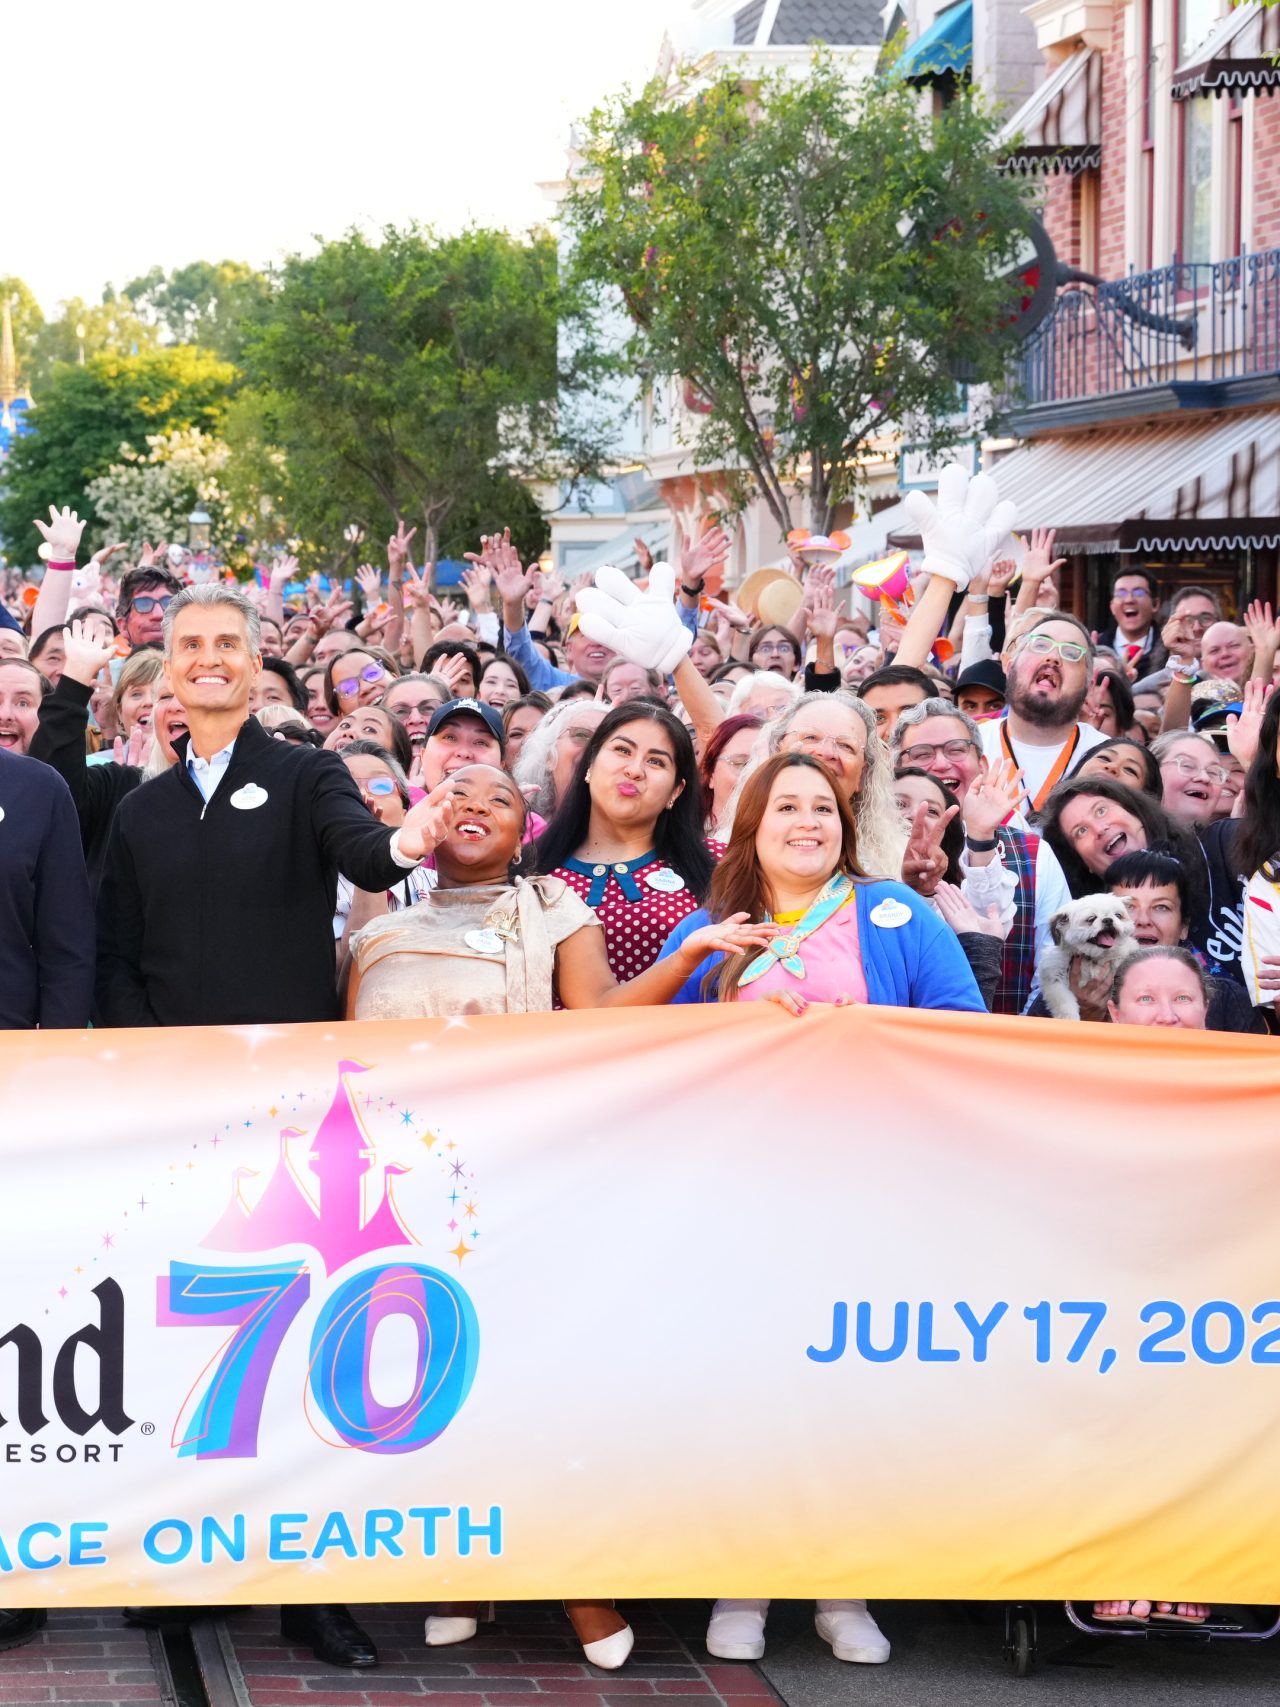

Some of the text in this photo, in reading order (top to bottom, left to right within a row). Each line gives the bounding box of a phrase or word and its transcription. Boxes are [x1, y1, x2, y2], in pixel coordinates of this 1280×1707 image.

[156, 1258, 480, 1460] 70
[806, 1301, 1009, 1363] JULY
[1023, 1300, 1117, 1375] 17,
[143, 1513, 245, 1564] ON
[269, 1505, 502, 1561] EARTH
